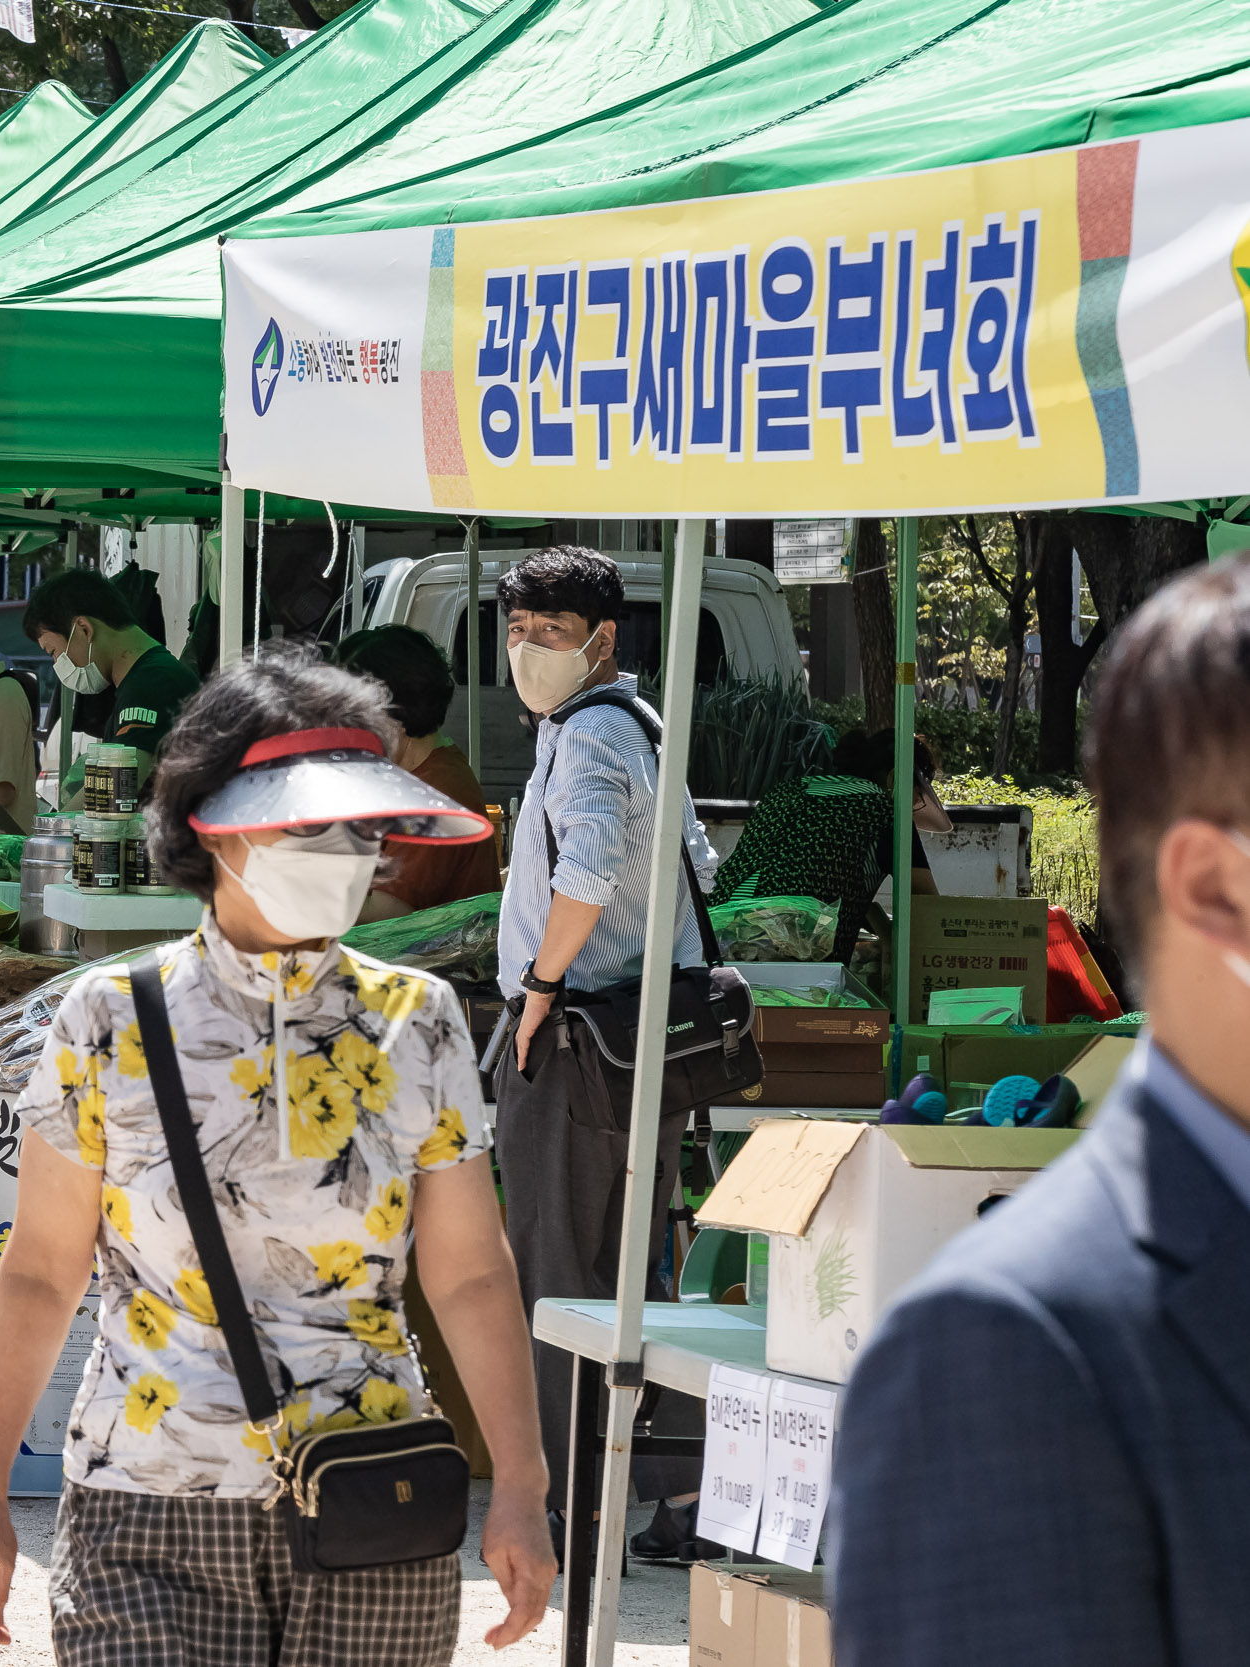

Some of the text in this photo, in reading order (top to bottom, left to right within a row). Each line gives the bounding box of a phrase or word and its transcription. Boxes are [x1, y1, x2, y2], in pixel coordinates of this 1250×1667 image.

[475, 216, 1039, 463] 광진구새마을부녀회
[118, 706, 158, 725] PUMA
[922, 955, 995, 970] LG 생활건강
[921, 975, 961, 993] 홈스타
[667, 1021, 694, 1034] Canon
